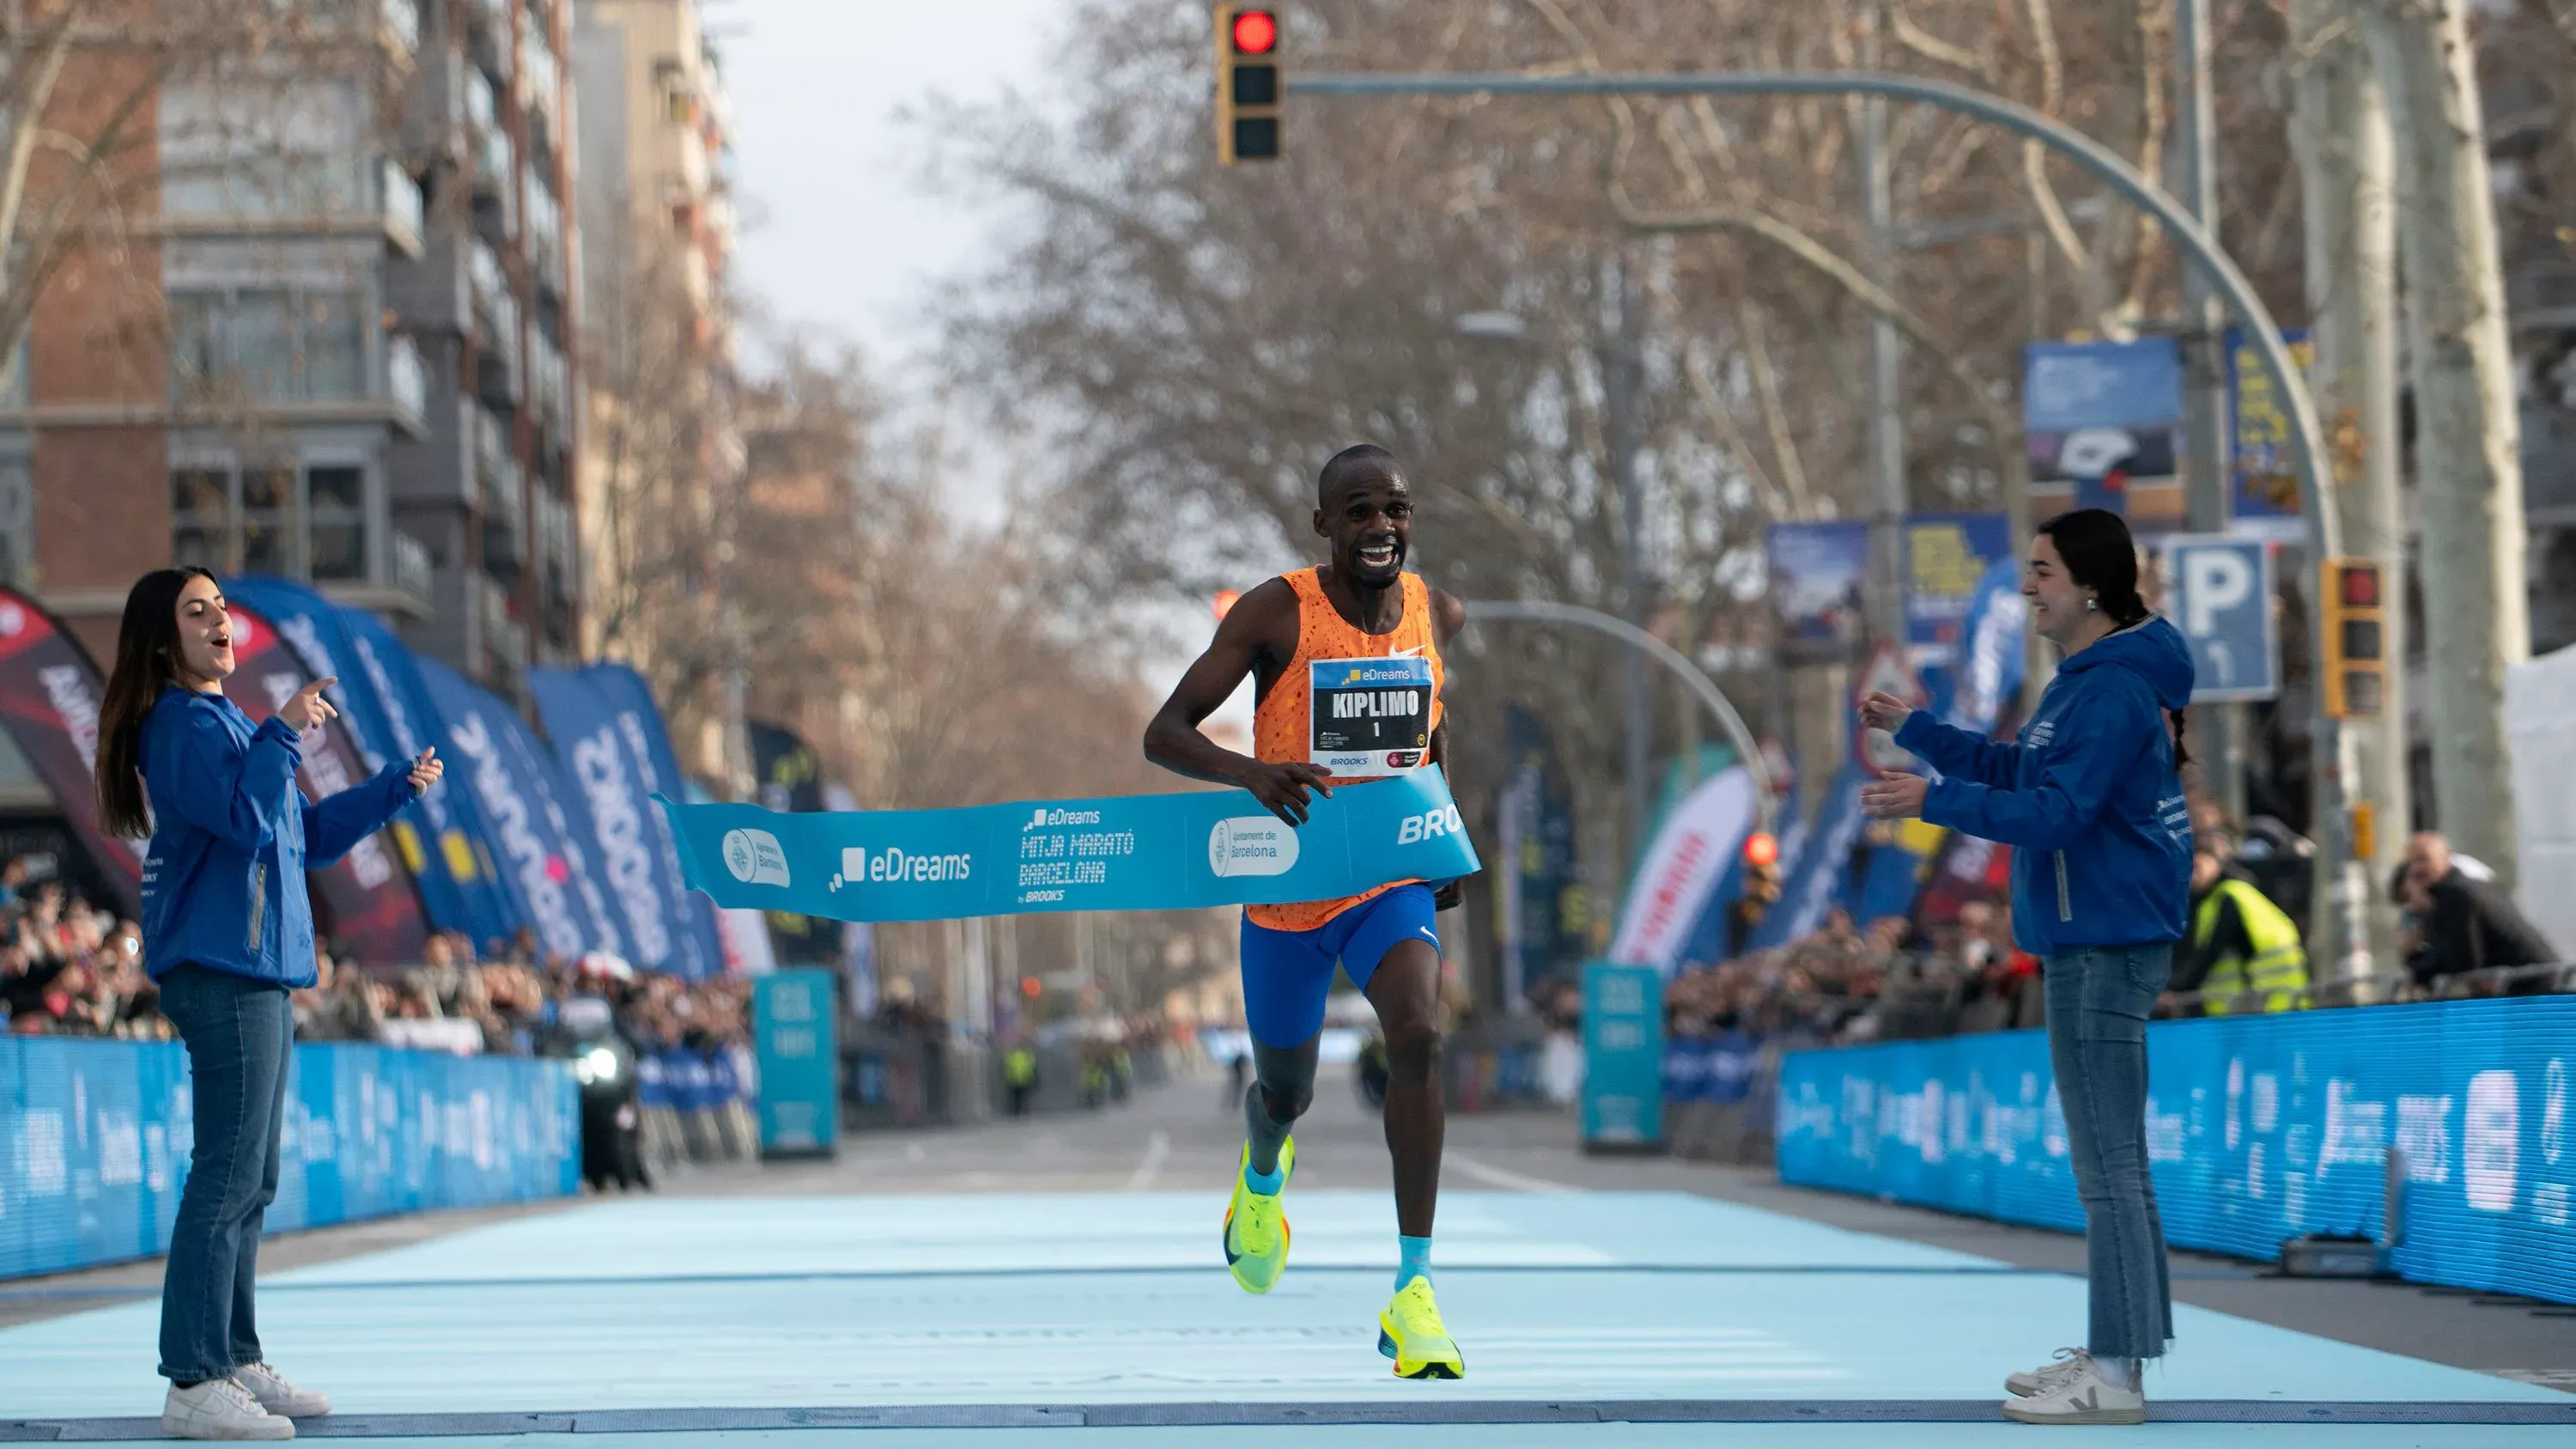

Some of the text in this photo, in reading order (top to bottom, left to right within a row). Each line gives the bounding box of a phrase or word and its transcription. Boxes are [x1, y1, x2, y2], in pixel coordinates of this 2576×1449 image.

[2186, 548, 2253, 636] P
[1363, 669, 1410, 681] eDreams
[1333, 691, 1419, 718] KIPLIMO
[1374, 722, 1380, 737] 1
[1048, 808, 1100, 825] eDreams
[1397, 803, 1463, 845] BRO
[1021, 828, 1134, 859] MITJA MARATÓ
[1266, 831, 1277, 841] de
[870, 847, 971, 882] eDreams
[1019, 861, 1107, 886] BARCELONA
[1025, 890, 1065, 903] BROOKS
